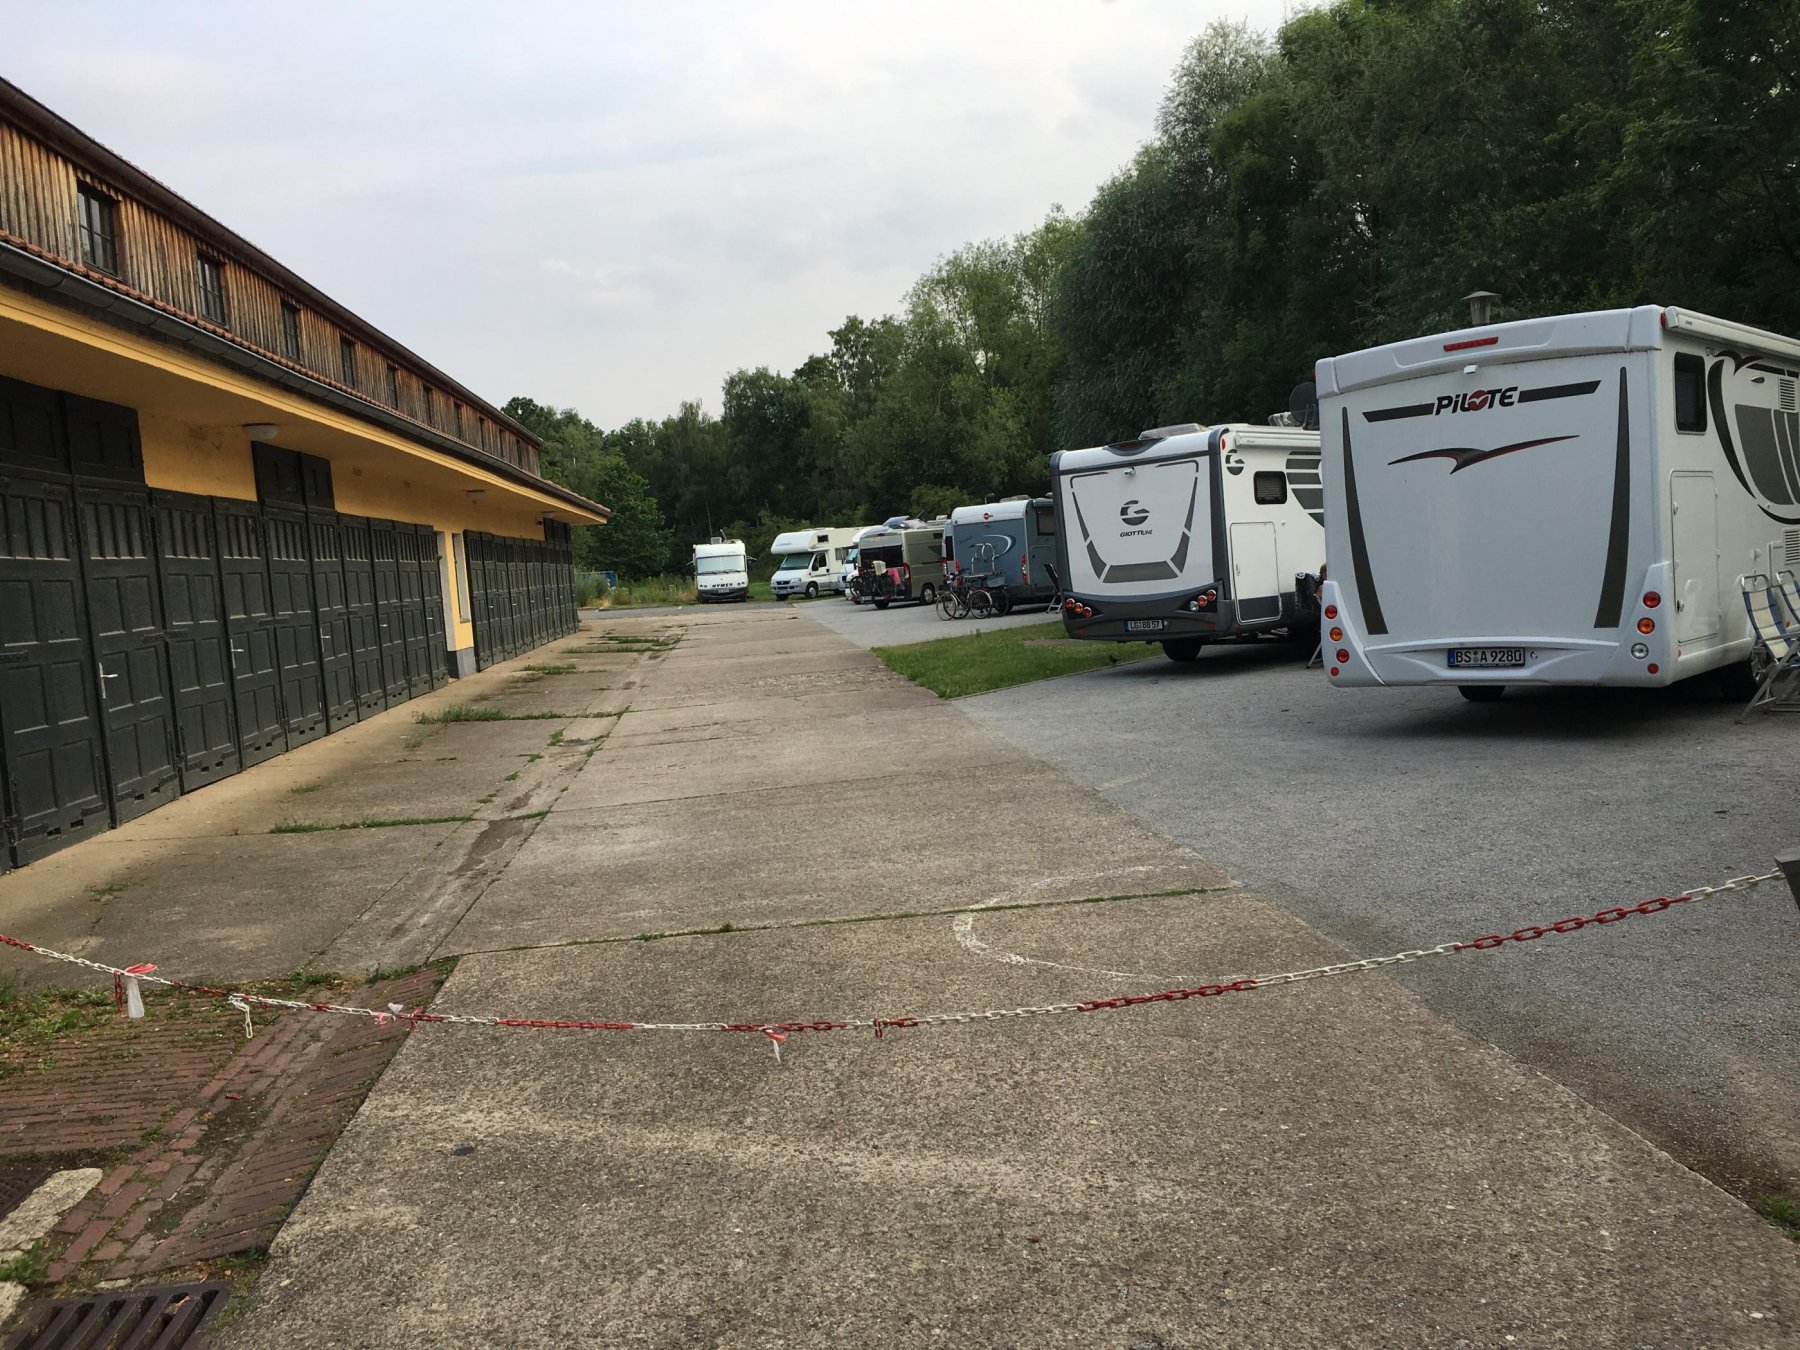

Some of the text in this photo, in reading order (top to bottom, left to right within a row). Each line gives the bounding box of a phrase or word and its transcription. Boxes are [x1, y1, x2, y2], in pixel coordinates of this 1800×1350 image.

[1455, 650, 1522, 663] BS A 9280
